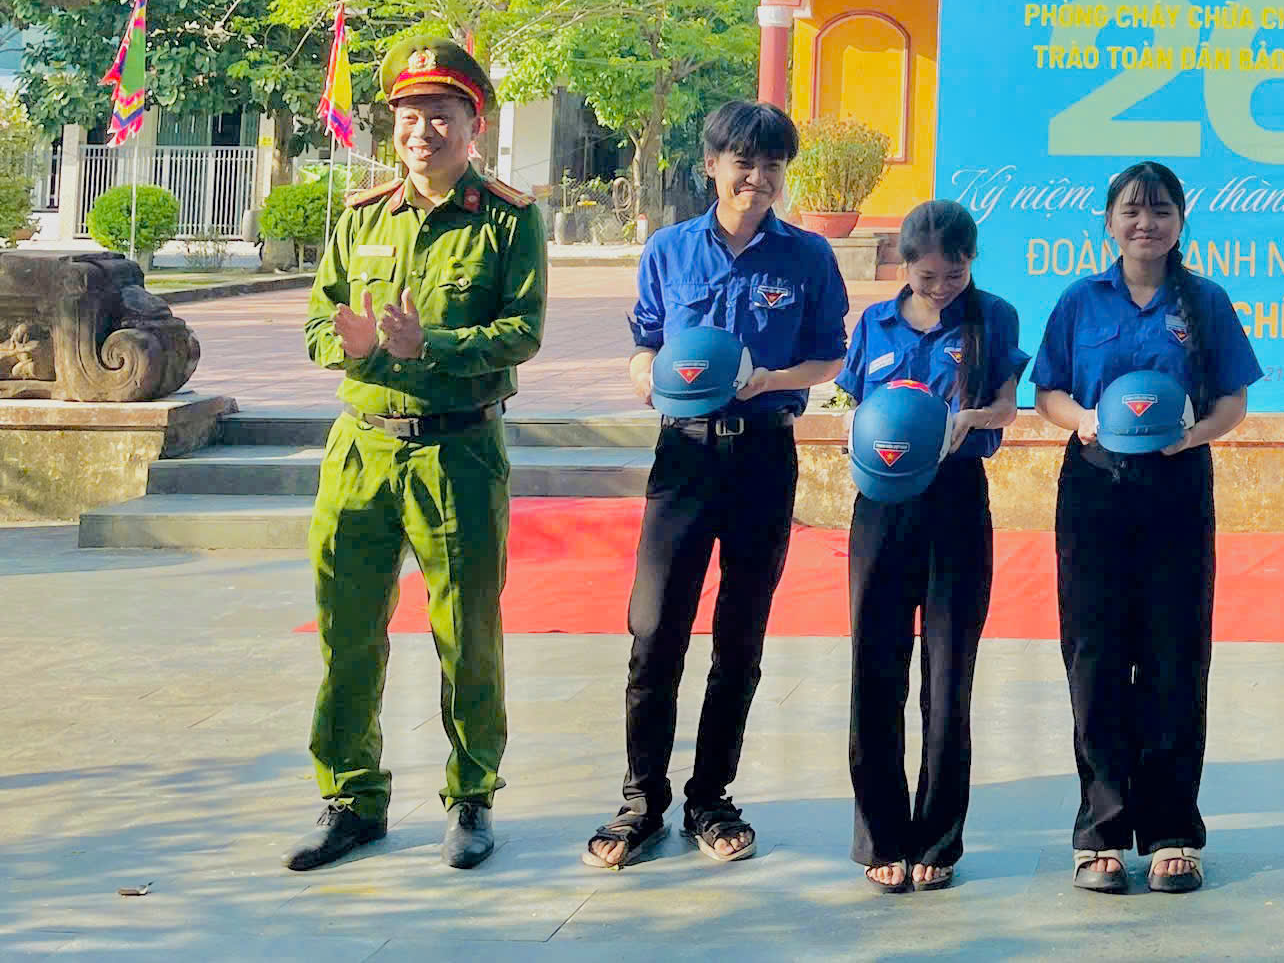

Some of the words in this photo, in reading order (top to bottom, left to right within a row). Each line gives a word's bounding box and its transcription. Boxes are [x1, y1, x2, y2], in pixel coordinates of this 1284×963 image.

[1115, 0, 1181, 28] CHÁY
[1188, 0, 1254, 30] CHỮA
[1033, 39, 1099, 70] TRÀO
[1106, 39, 1174, 71] TOÀN
[1180, 41, 1232, 71] DÂN
[952, 164, 1017, 225] Kỷ
[1010, 176, 1096, 219] niệm
[1184, 239, 1257, 278] ANH
